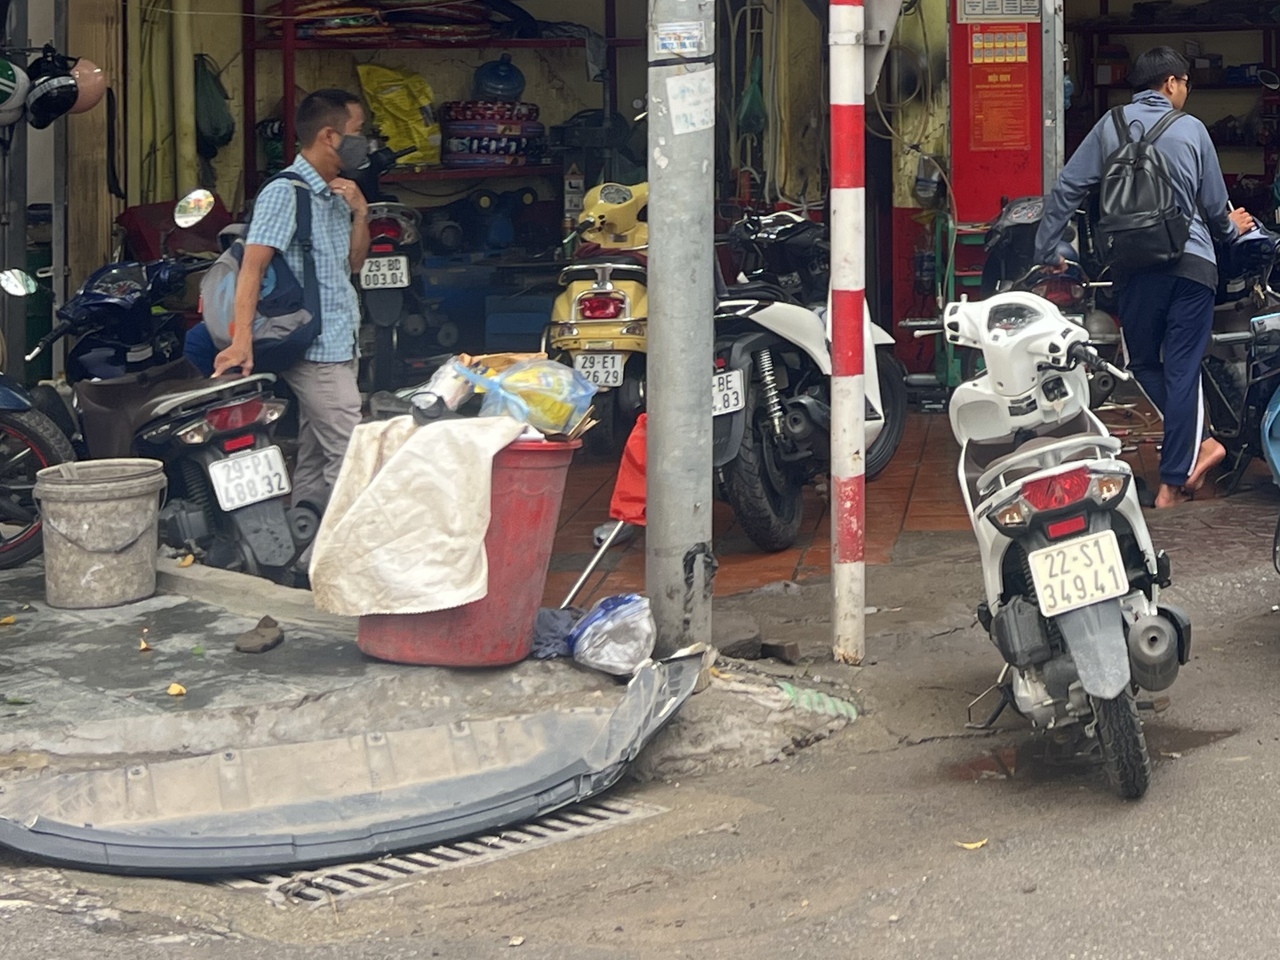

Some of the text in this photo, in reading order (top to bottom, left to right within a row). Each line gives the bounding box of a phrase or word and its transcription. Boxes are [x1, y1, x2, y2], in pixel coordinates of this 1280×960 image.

[368, 259, 401, 272] 29-BD
[581, 356, 615, 369] 29-E1
[584, 370, 619, 383] 26.29
[222, 453, 273, 483] 29-P1
[224, 472, 286, 505] 488.32
[1044, 539, 1105, 579] 22-S1
[1043, 565, 1120, 609] 349.41
